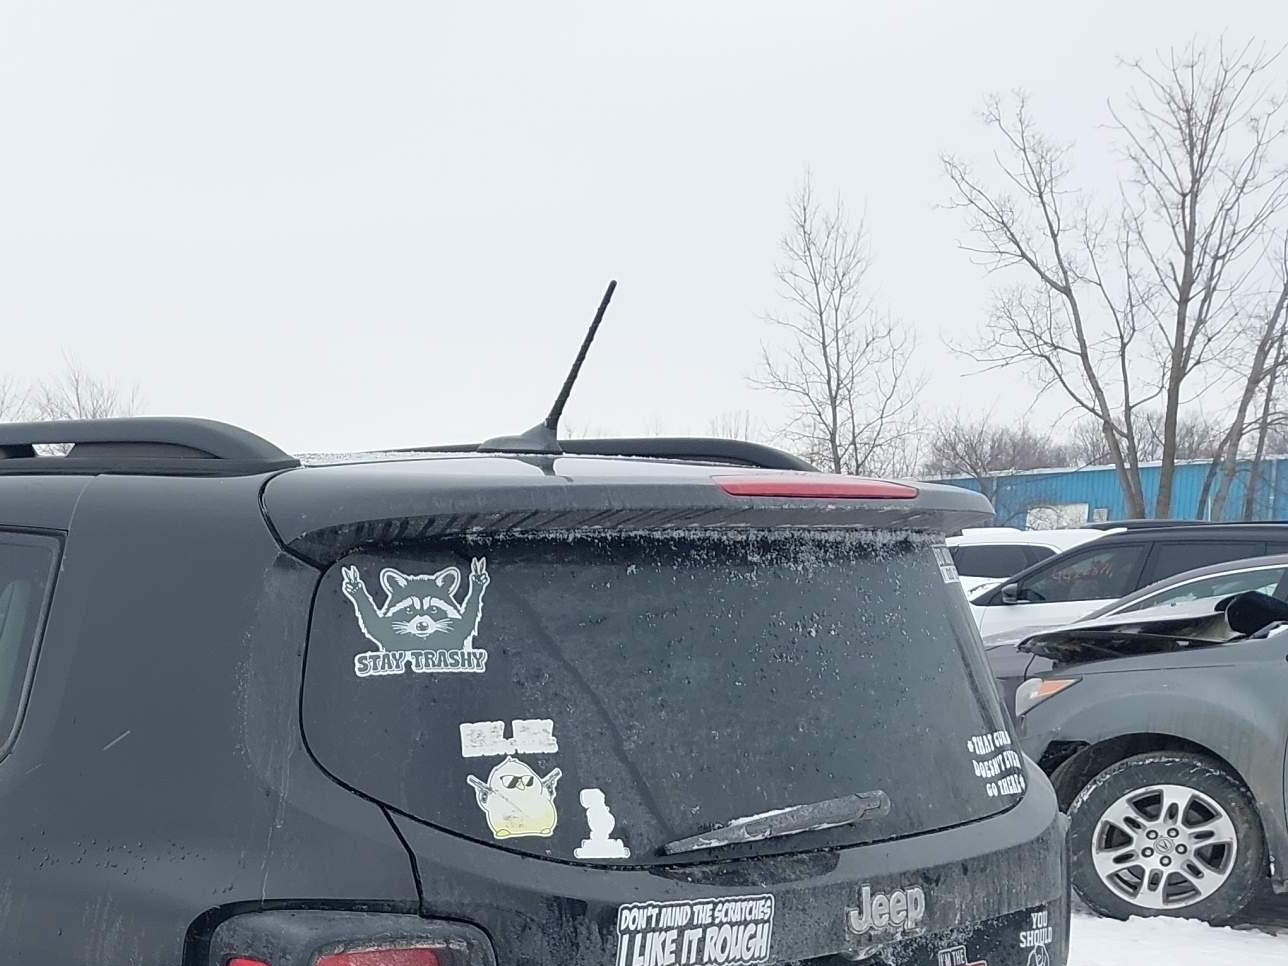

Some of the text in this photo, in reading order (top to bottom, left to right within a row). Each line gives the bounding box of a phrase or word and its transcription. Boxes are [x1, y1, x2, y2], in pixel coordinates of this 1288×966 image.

[357, 651, 485, 673] STAY TRASHY
[972, 733, 994, 755] THAT
[986, 782, 999, 797] GO
[620, 899, 772, 930] DON'T MIND THE SCRATCHES
[847, 883, 925, 934] Jeep
[1031, 911, 1048, 929] YOU
[681, 928, 703, 964] IT
[703, 923, 769, 963] ROUGH
[1019, 927, 1053, 948] SHOULD
[952, 949, 966, 966] THE
